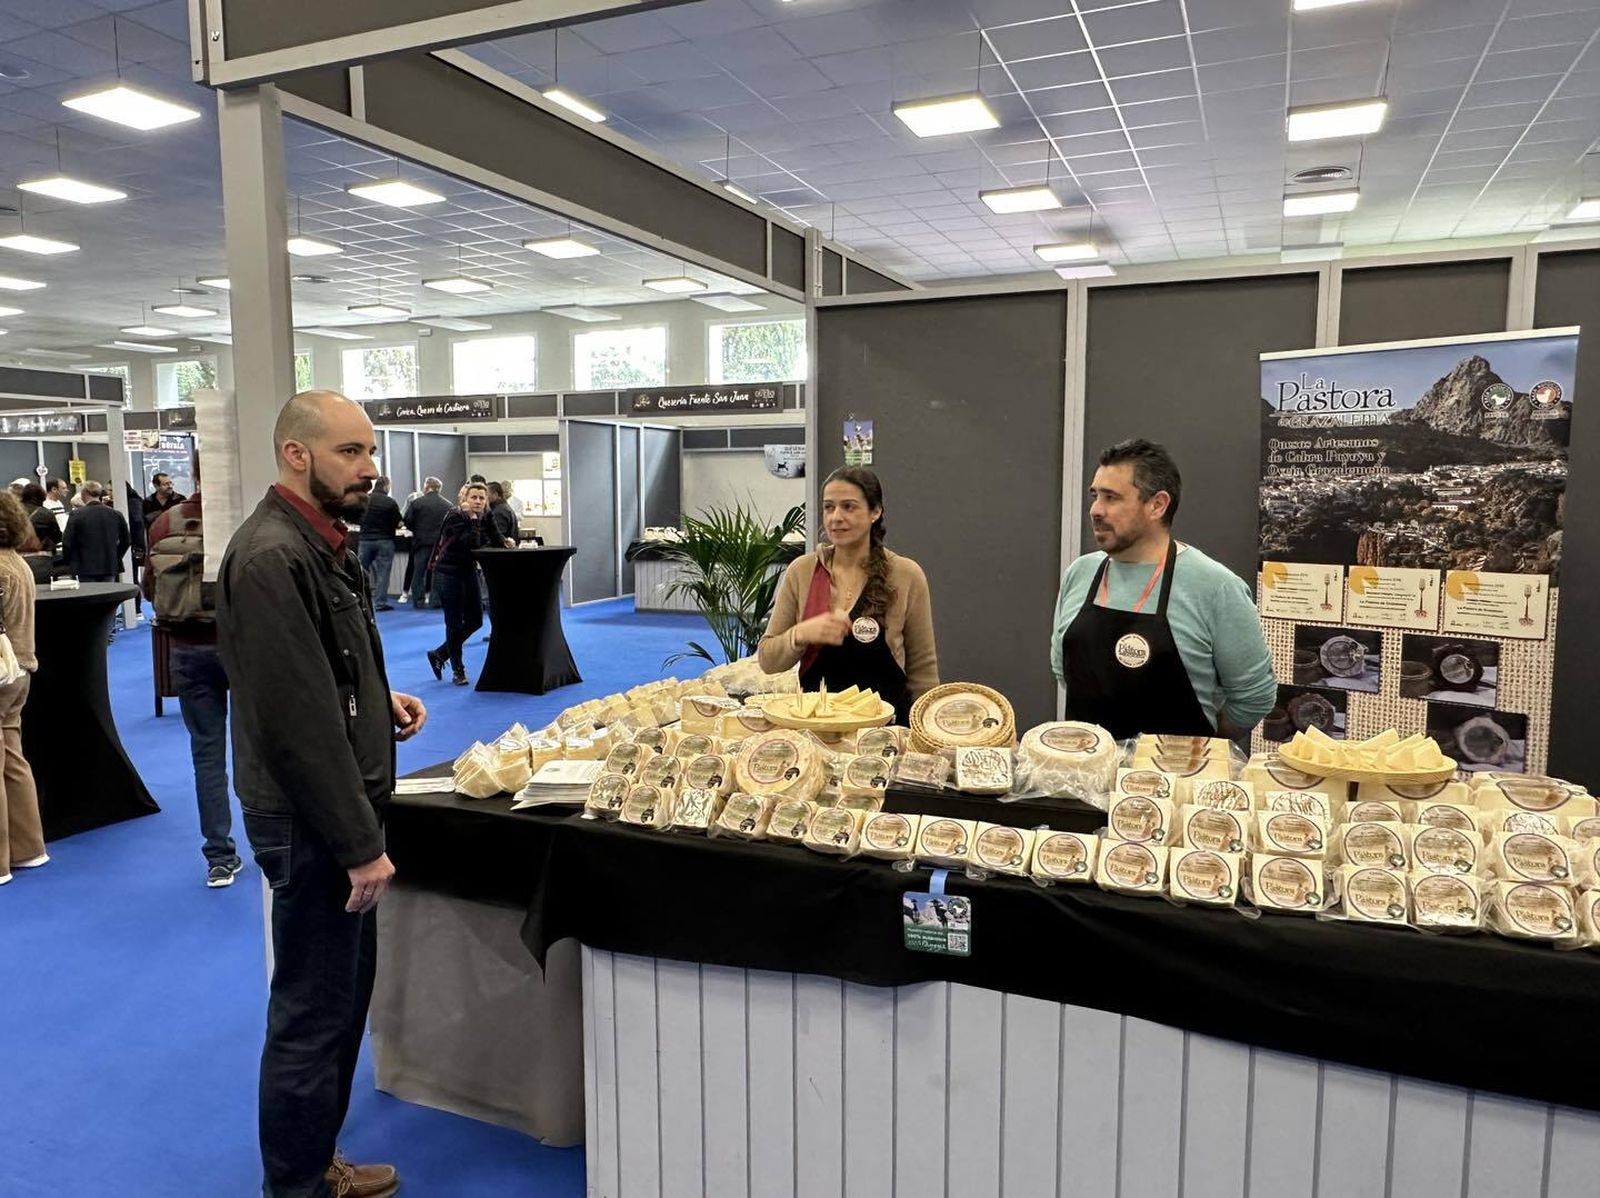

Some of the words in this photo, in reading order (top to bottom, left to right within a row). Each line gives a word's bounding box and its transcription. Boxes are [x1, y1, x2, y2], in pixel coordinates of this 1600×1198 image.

[1301, 372, 1324, 390] La
[689, 393, 711, 406] Fuente
[712, 391, 728, 405] San
[729, 390, 749, 403] Juan
[1276, 381, 1396, 412] Pastora
[1289, 413, 1392, 429] GRAZALEMA
[1268, 438, 1312, 451] Quesos
[1313, 437, 1380, 450] Artesanos
[1267, 450, 1283, 463] de
[1285, 449, 1323, 463] Cabra
[1325, 448, 1375, 464] Payoya
[1376, 446, 1388, 467] y
[1267, 464, 1303, 477] Oveja
